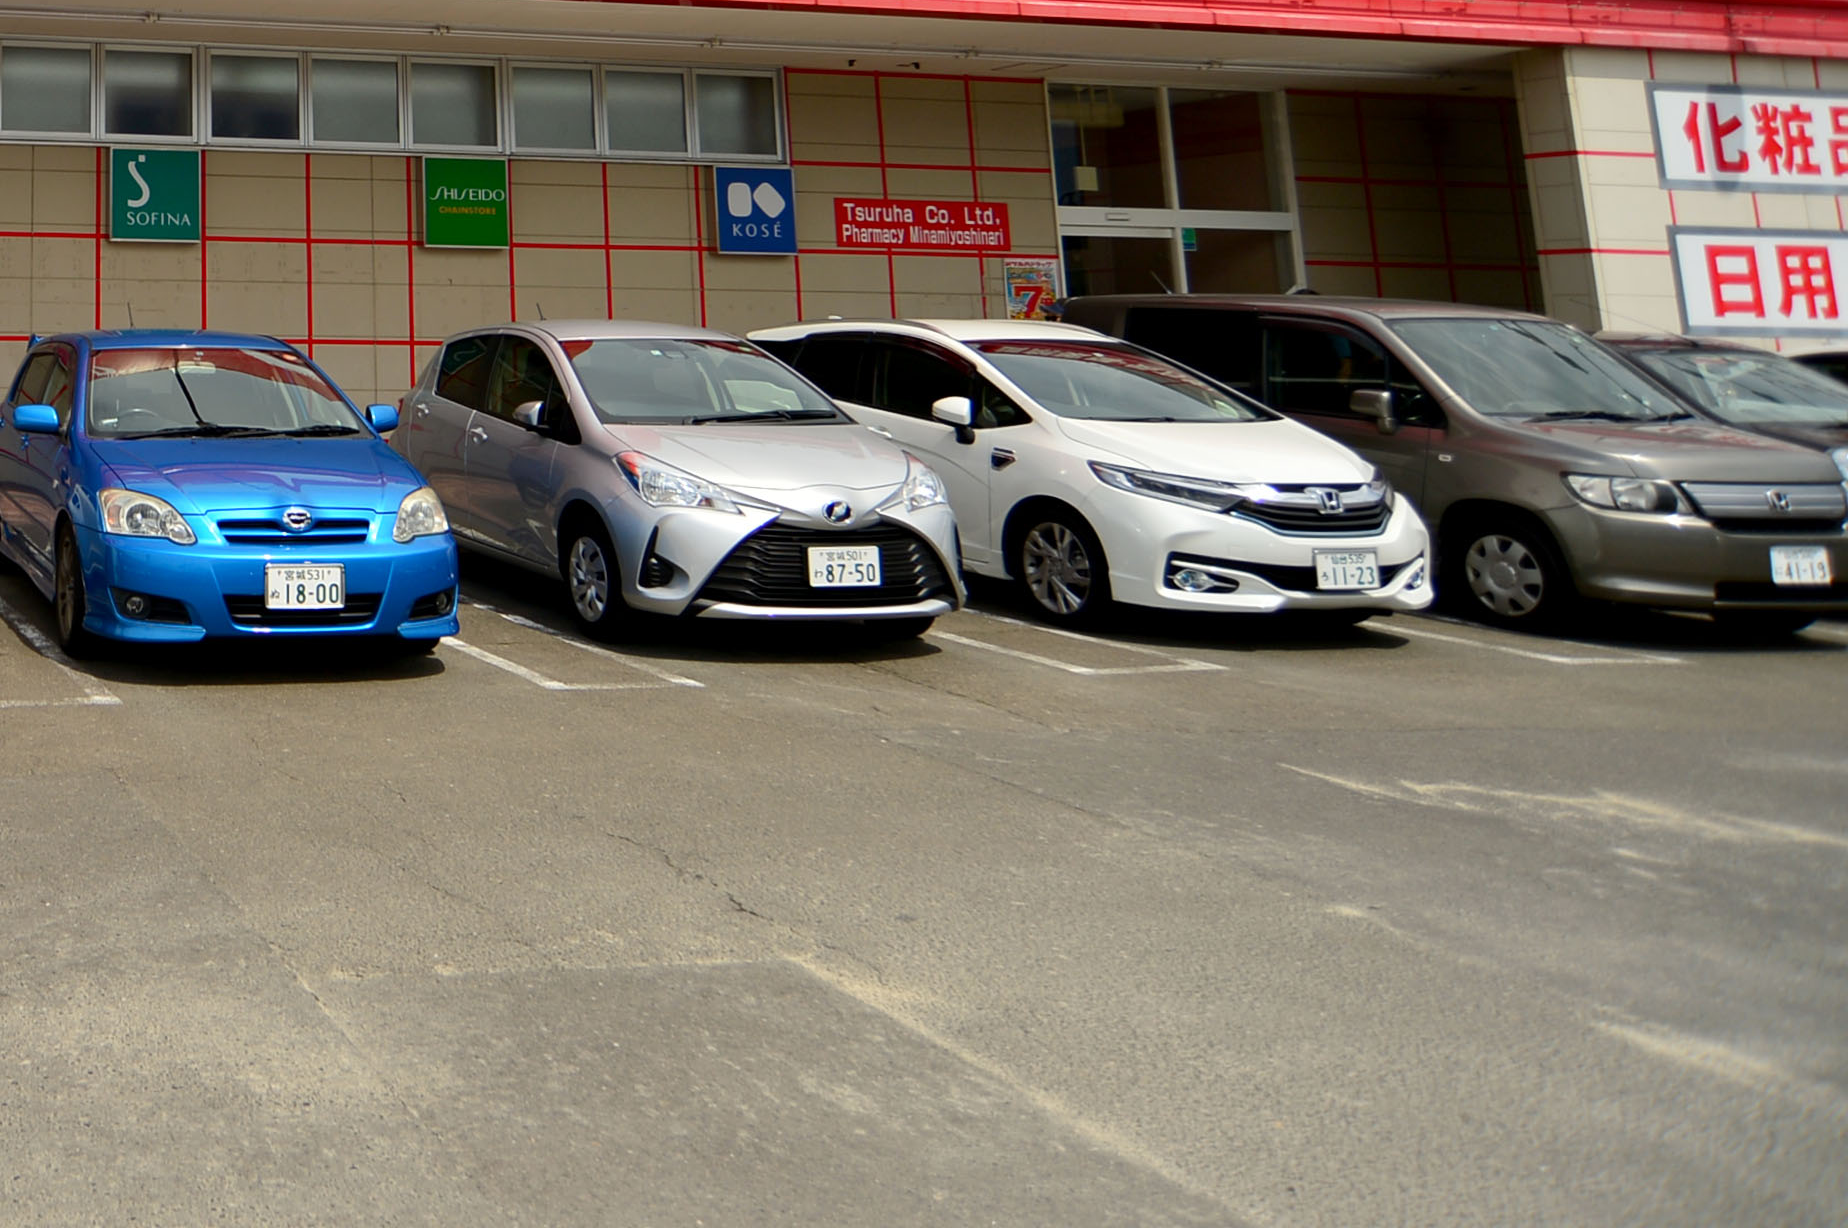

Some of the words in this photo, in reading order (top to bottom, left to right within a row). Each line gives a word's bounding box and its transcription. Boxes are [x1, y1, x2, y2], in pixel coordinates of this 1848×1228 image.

[430, 186, 505, 202] SHISEIDO
[126, 211, 191, 226] SOFINA
[843, 203, 913, 222] Tsuruha
[925, 205, 955, 224] Co.
[964, 206, 1000, 225] Ltd.
[732, 221, 782, 238] KOSÉ
[842, 224, 904, 244] Pharmacy
[909, 226, 1004, 245] Minamiyoshinari
[1704, 244, 1839, 319] 日用
[1014, 285, 1044, 319] 7
[826, 563, 876, 583] 87-50
[286, 583, 339, 604] 18-00
